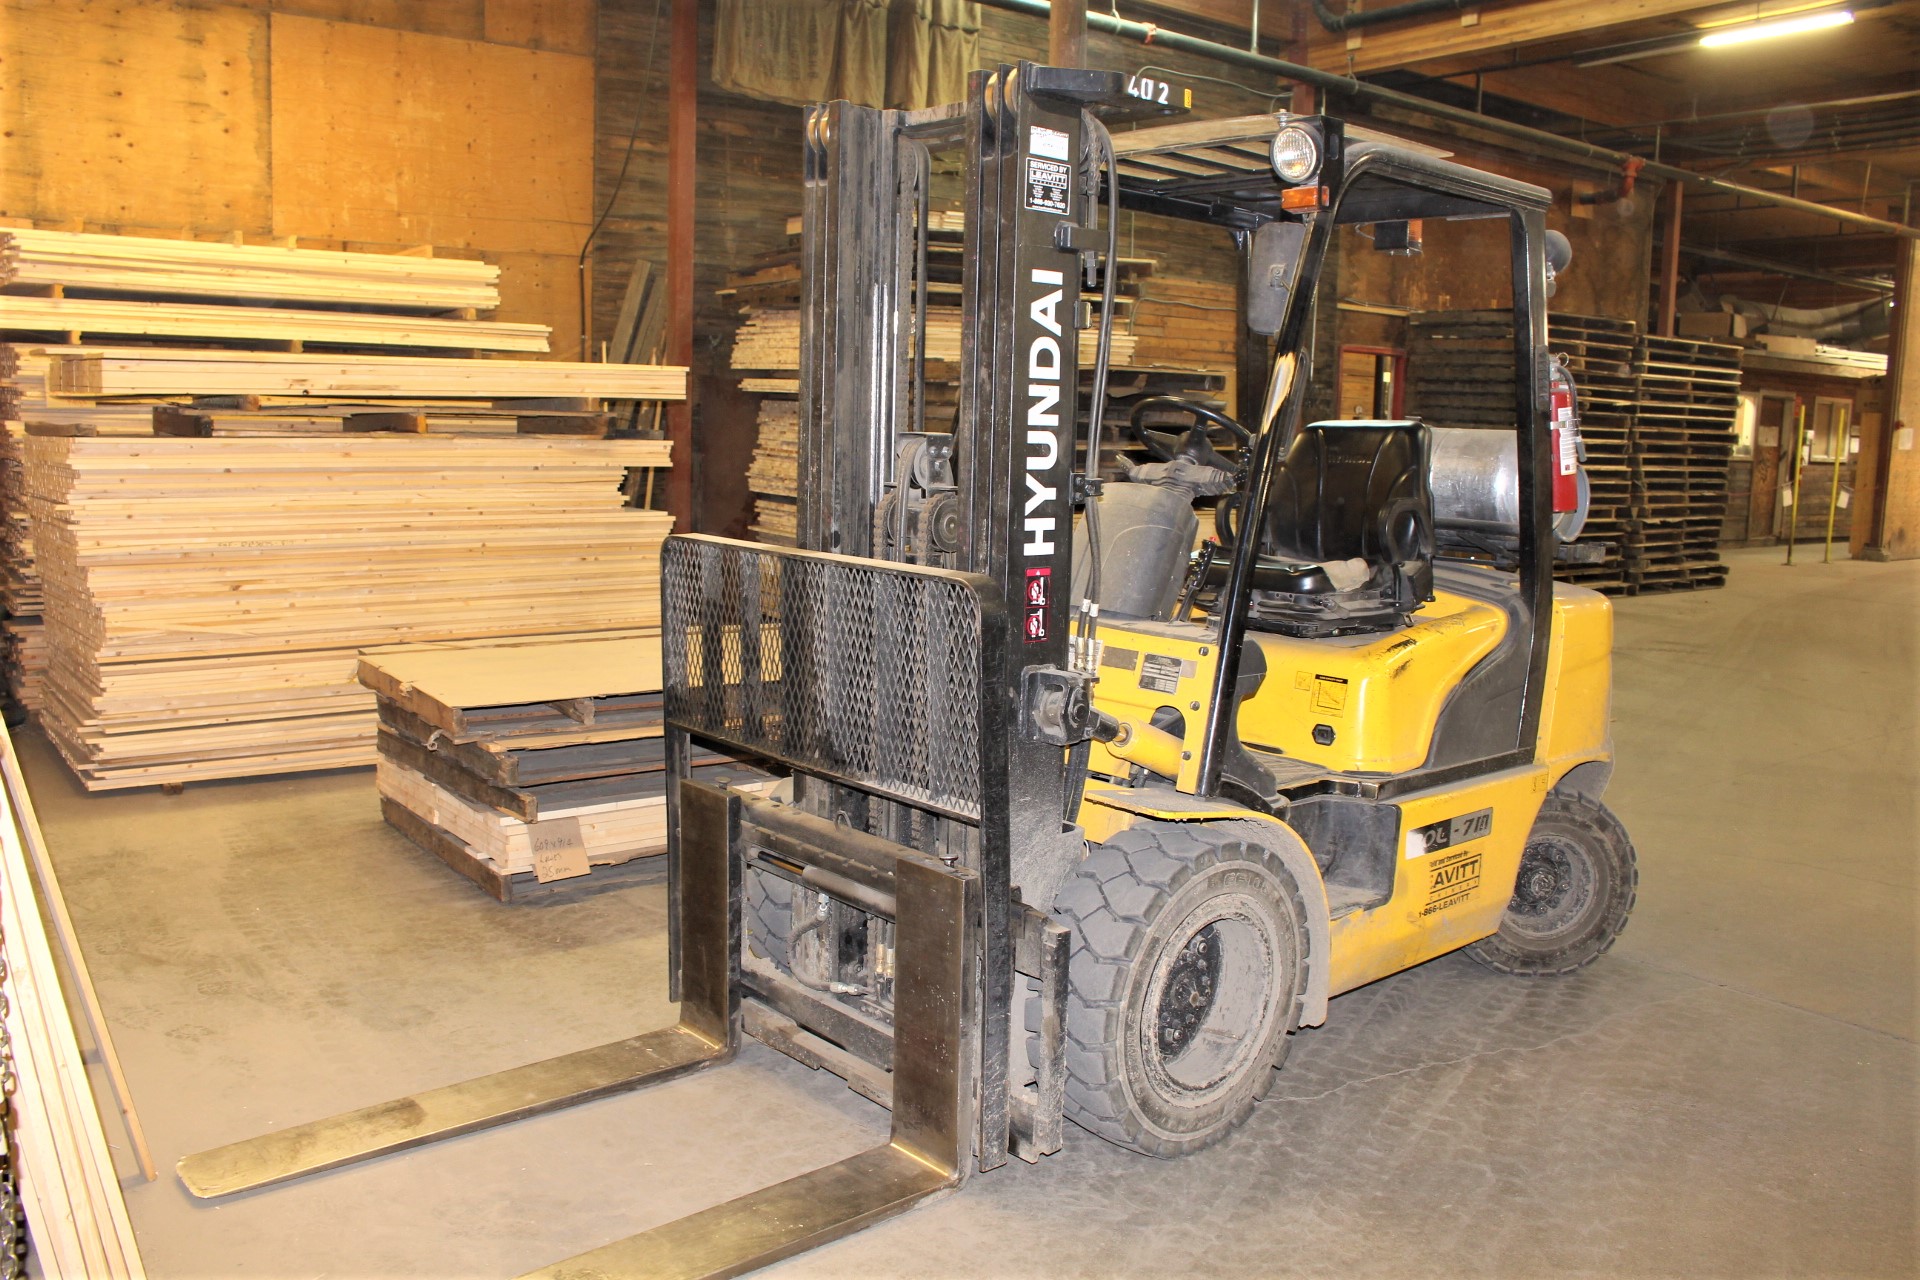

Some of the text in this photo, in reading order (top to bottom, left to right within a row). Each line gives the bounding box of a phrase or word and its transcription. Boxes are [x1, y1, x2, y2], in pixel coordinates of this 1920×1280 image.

[1030, 161, 1067, 174] SERVICED BY
[1031, 170, 1066, 183] LEAVITT
[1024, 269, 1064, 556] HYUNDAI
[1431, 859, 1479, 887] AVITT
